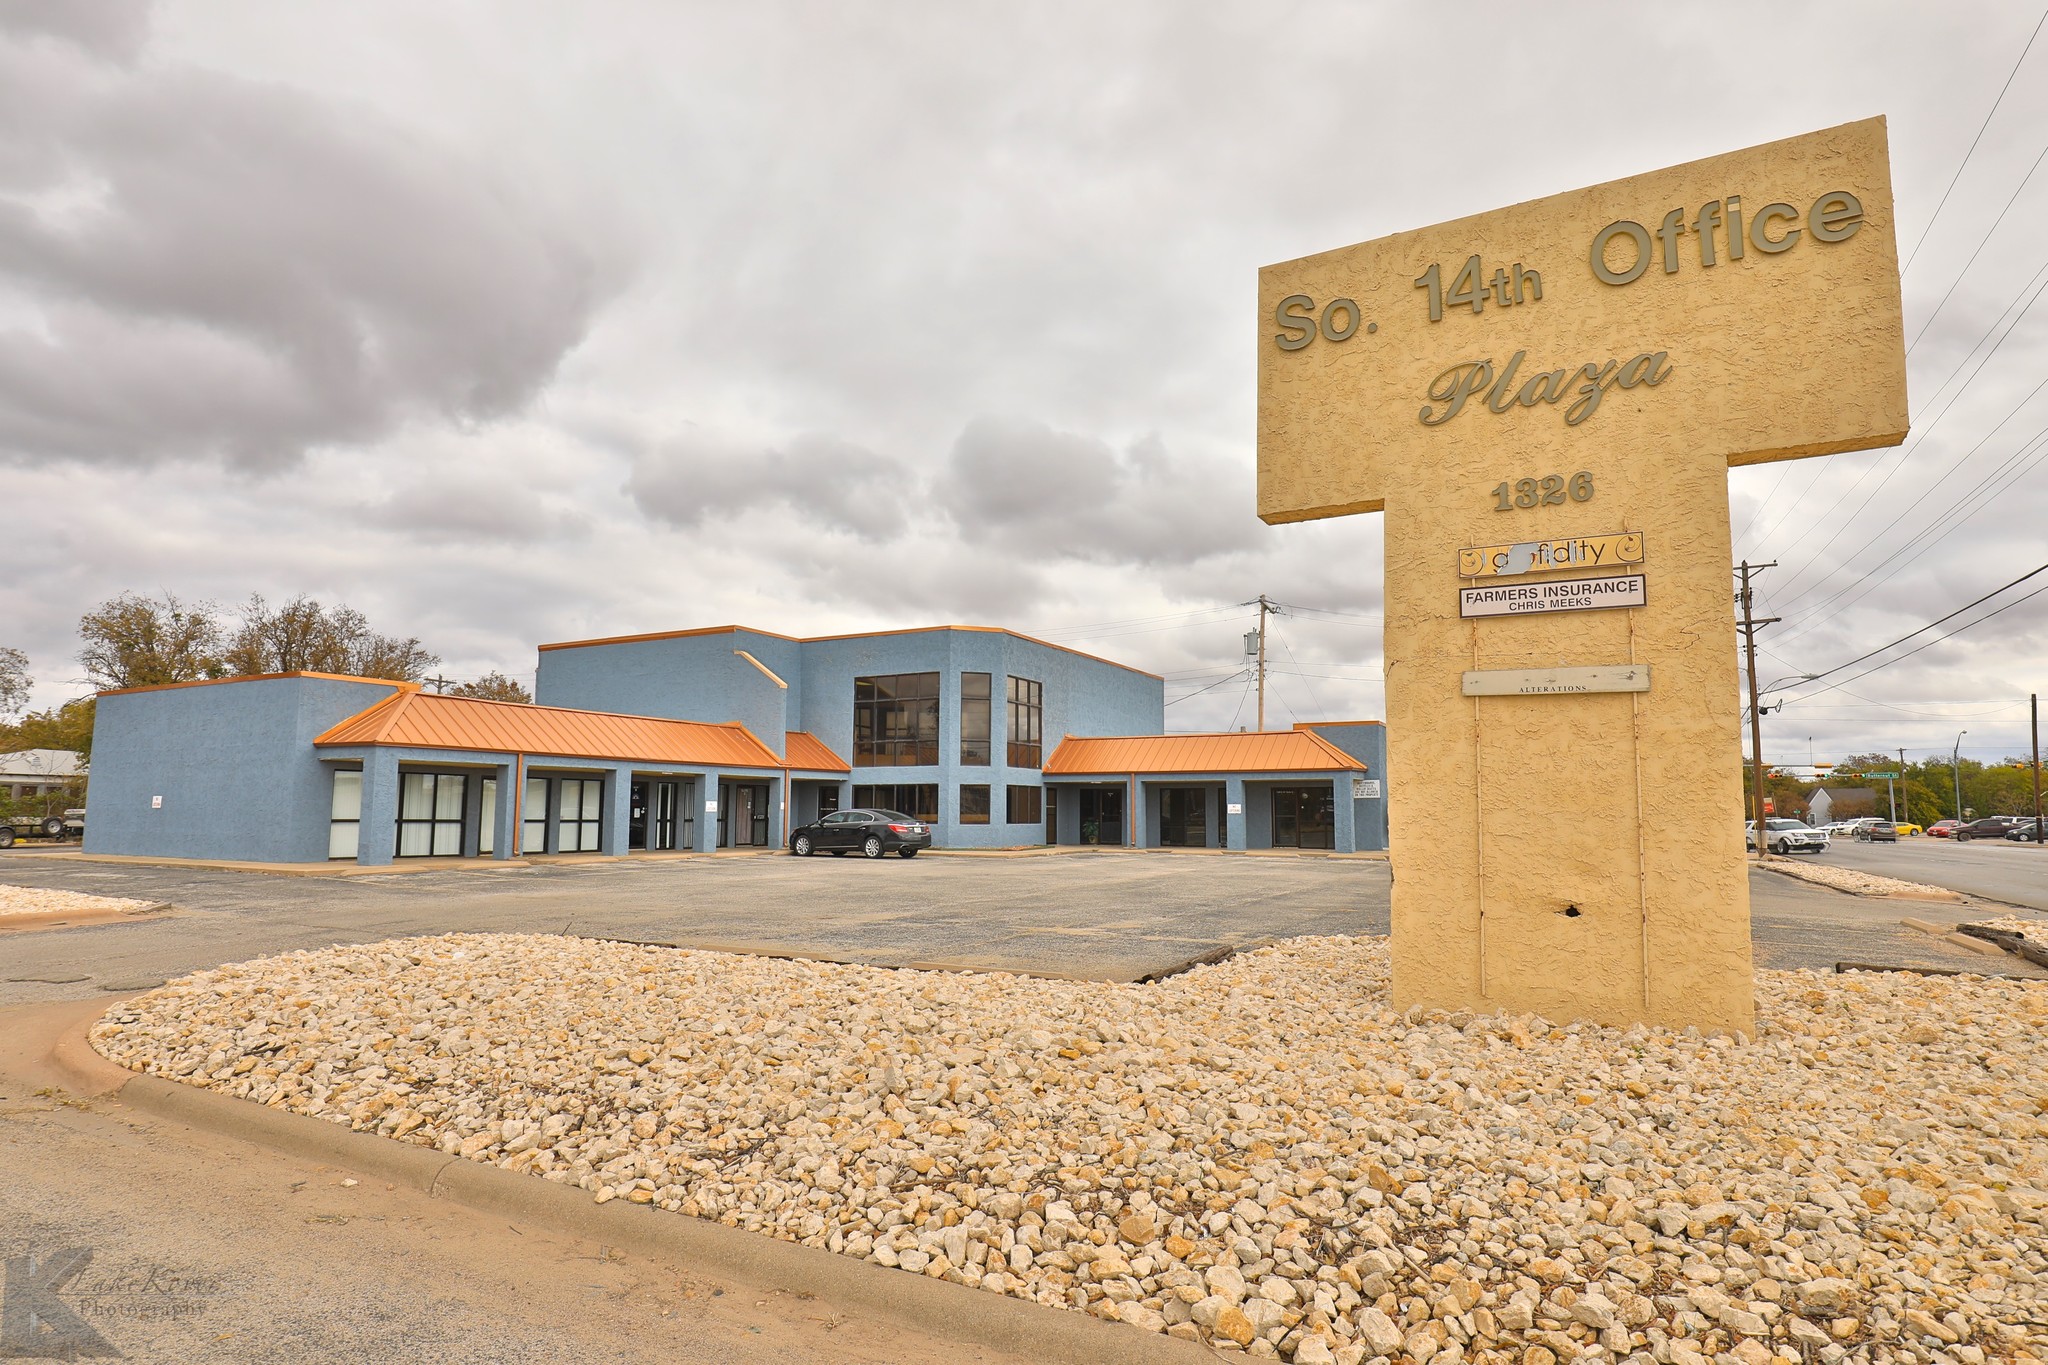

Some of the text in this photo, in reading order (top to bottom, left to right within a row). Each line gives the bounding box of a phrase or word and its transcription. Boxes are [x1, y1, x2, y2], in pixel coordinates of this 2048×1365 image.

[1274, 190, 1864, 352] So. 14th Office
[1418, 350, 1674, 426] Plaza
[1491, 471, 1595, 512] 1326
[1466, 580, 1639, 604] FARMERS INSURANCE
[1509, 597, 1592, 612] CHRIS MEEKS
[1519, 685, 1588, 693] ALTERATIONS
